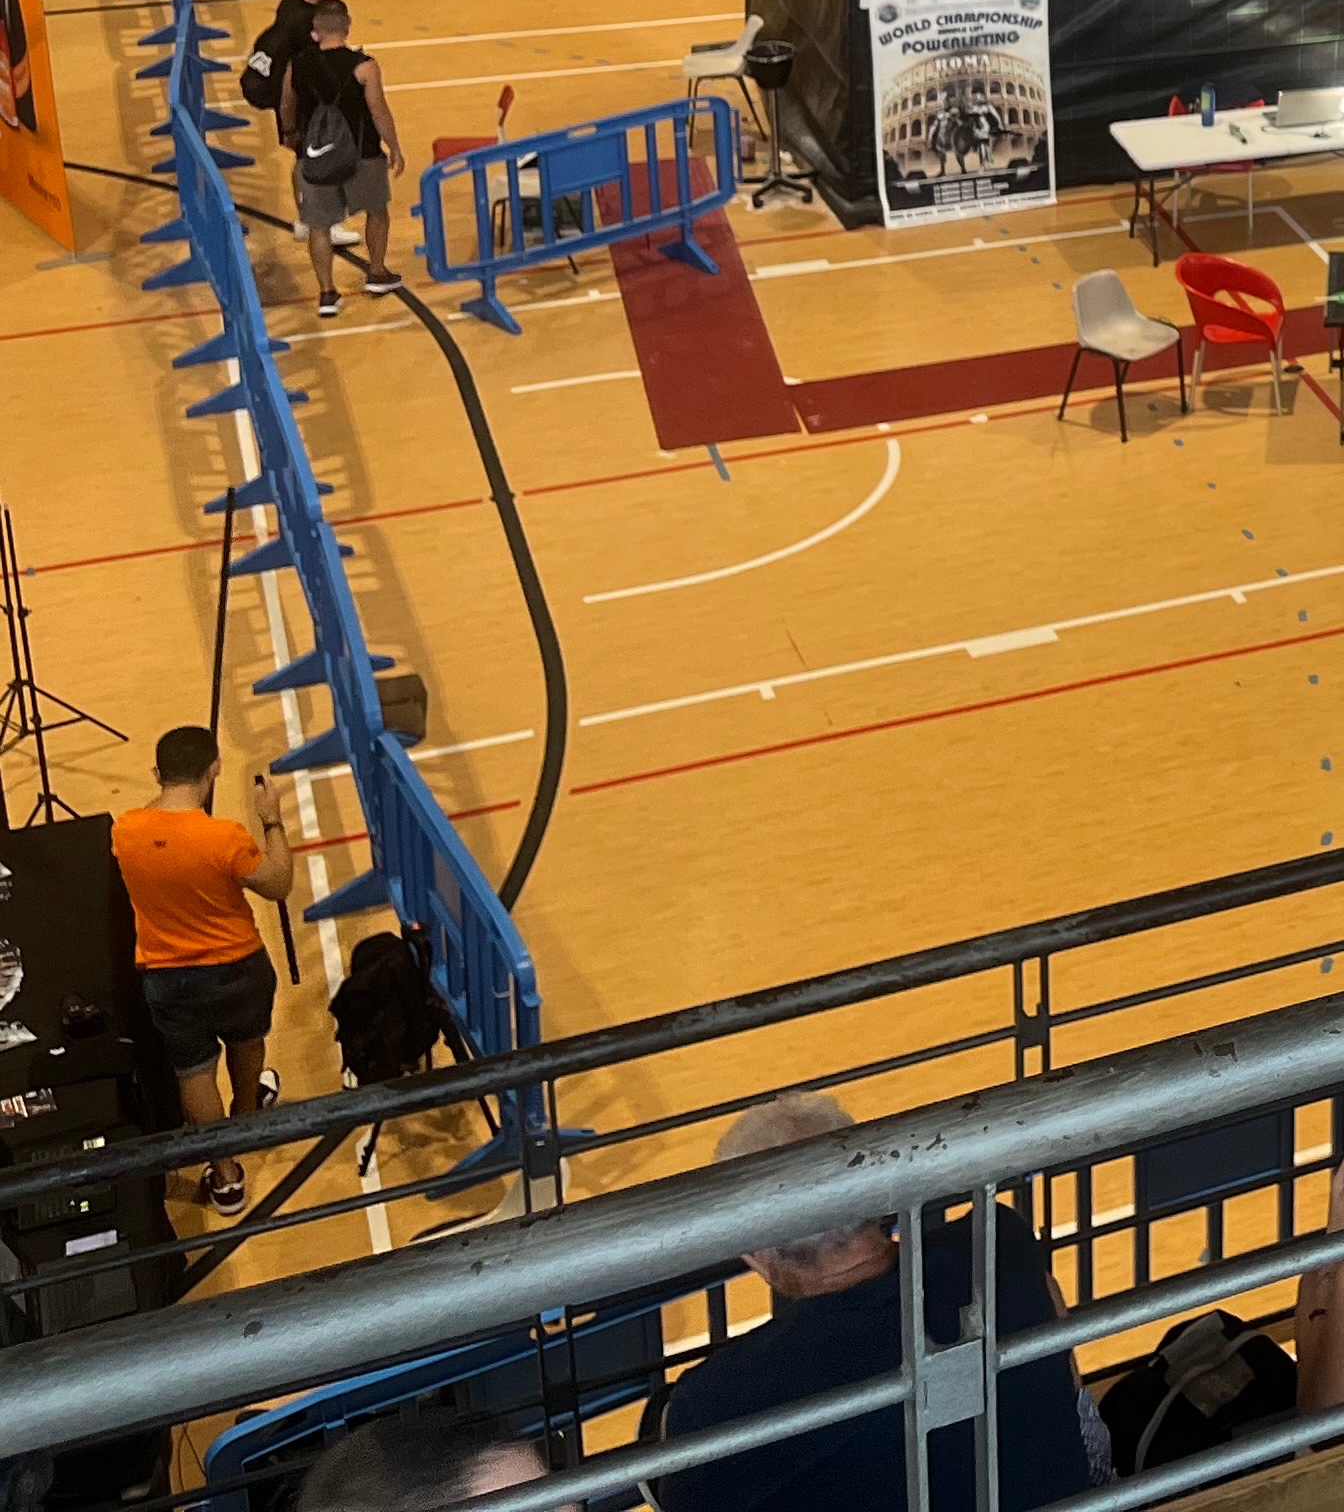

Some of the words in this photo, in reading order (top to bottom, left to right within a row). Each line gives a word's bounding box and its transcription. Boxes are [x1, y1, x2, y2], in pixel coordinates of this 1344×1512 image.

[879, 19, 932, 46] WORLD
[936, 12, 1043, 30] CHAMPIONSHIP
[902, 30, 1020, 55] POWERLIFTING
[935, 54, 990, 72] ROMA
